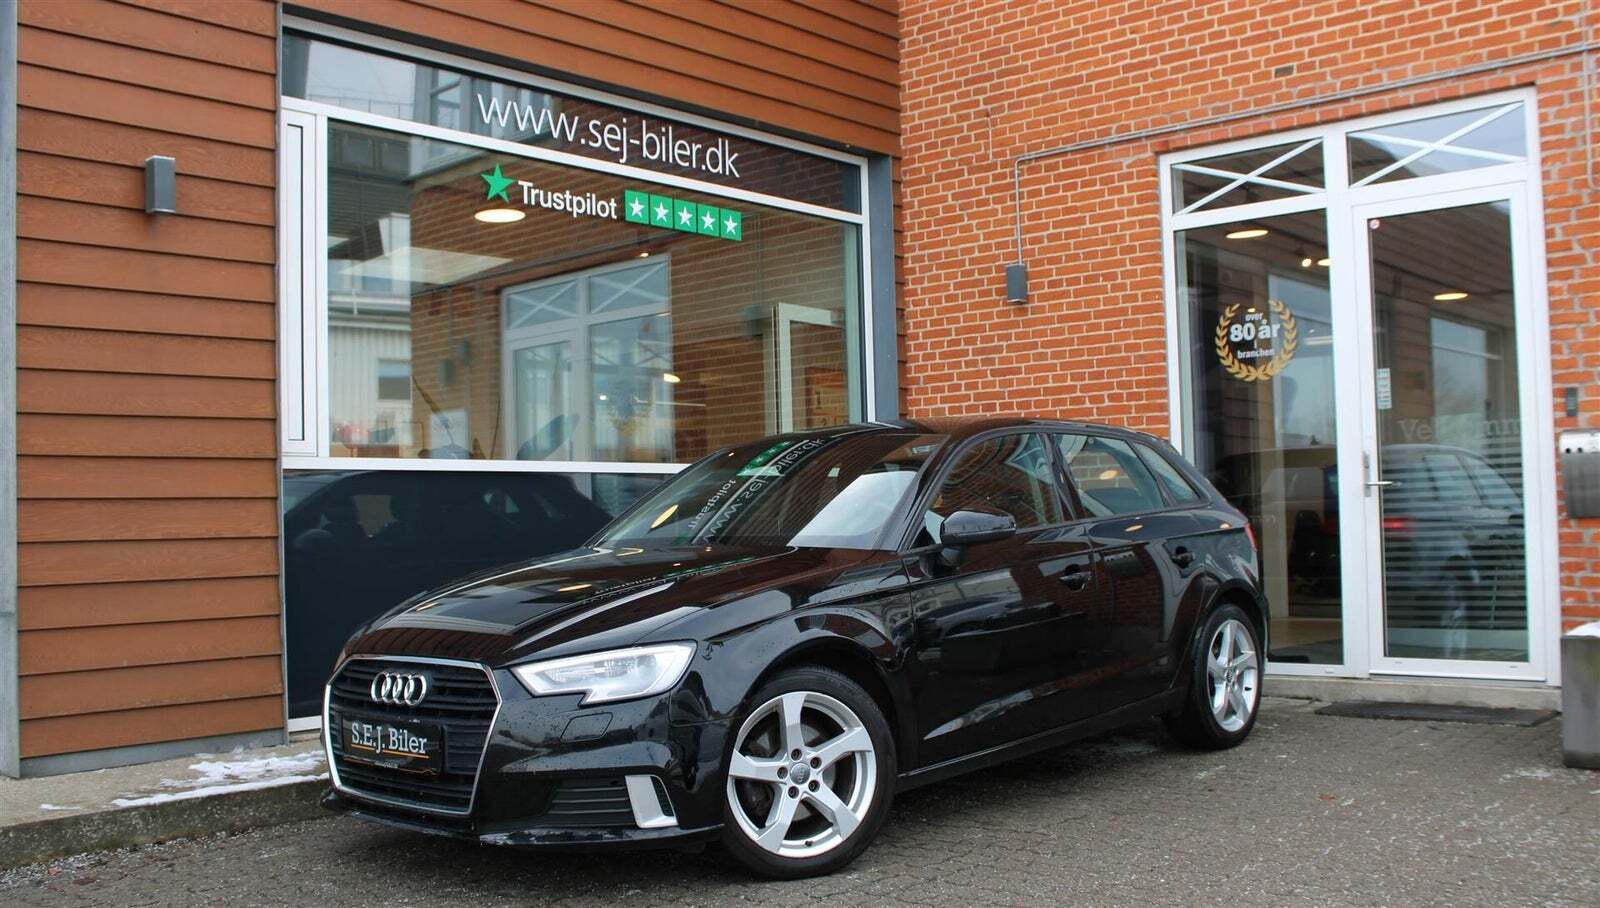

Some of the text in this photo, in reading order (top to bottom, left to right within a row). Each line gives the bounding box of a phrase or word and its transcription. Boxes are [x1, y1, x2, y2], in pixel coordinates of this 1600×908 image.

[478, 93, 740, 178] www.sej-biler.dk
[517, 180, 618, 219] Trustpilot
[1229, 319, 1281, 342] 80 år
[1245, 312, 1263, 322] over
[1237, 348, 1275, 359] branchen
[351, 720, 428, 754] S.E.J. Biler
